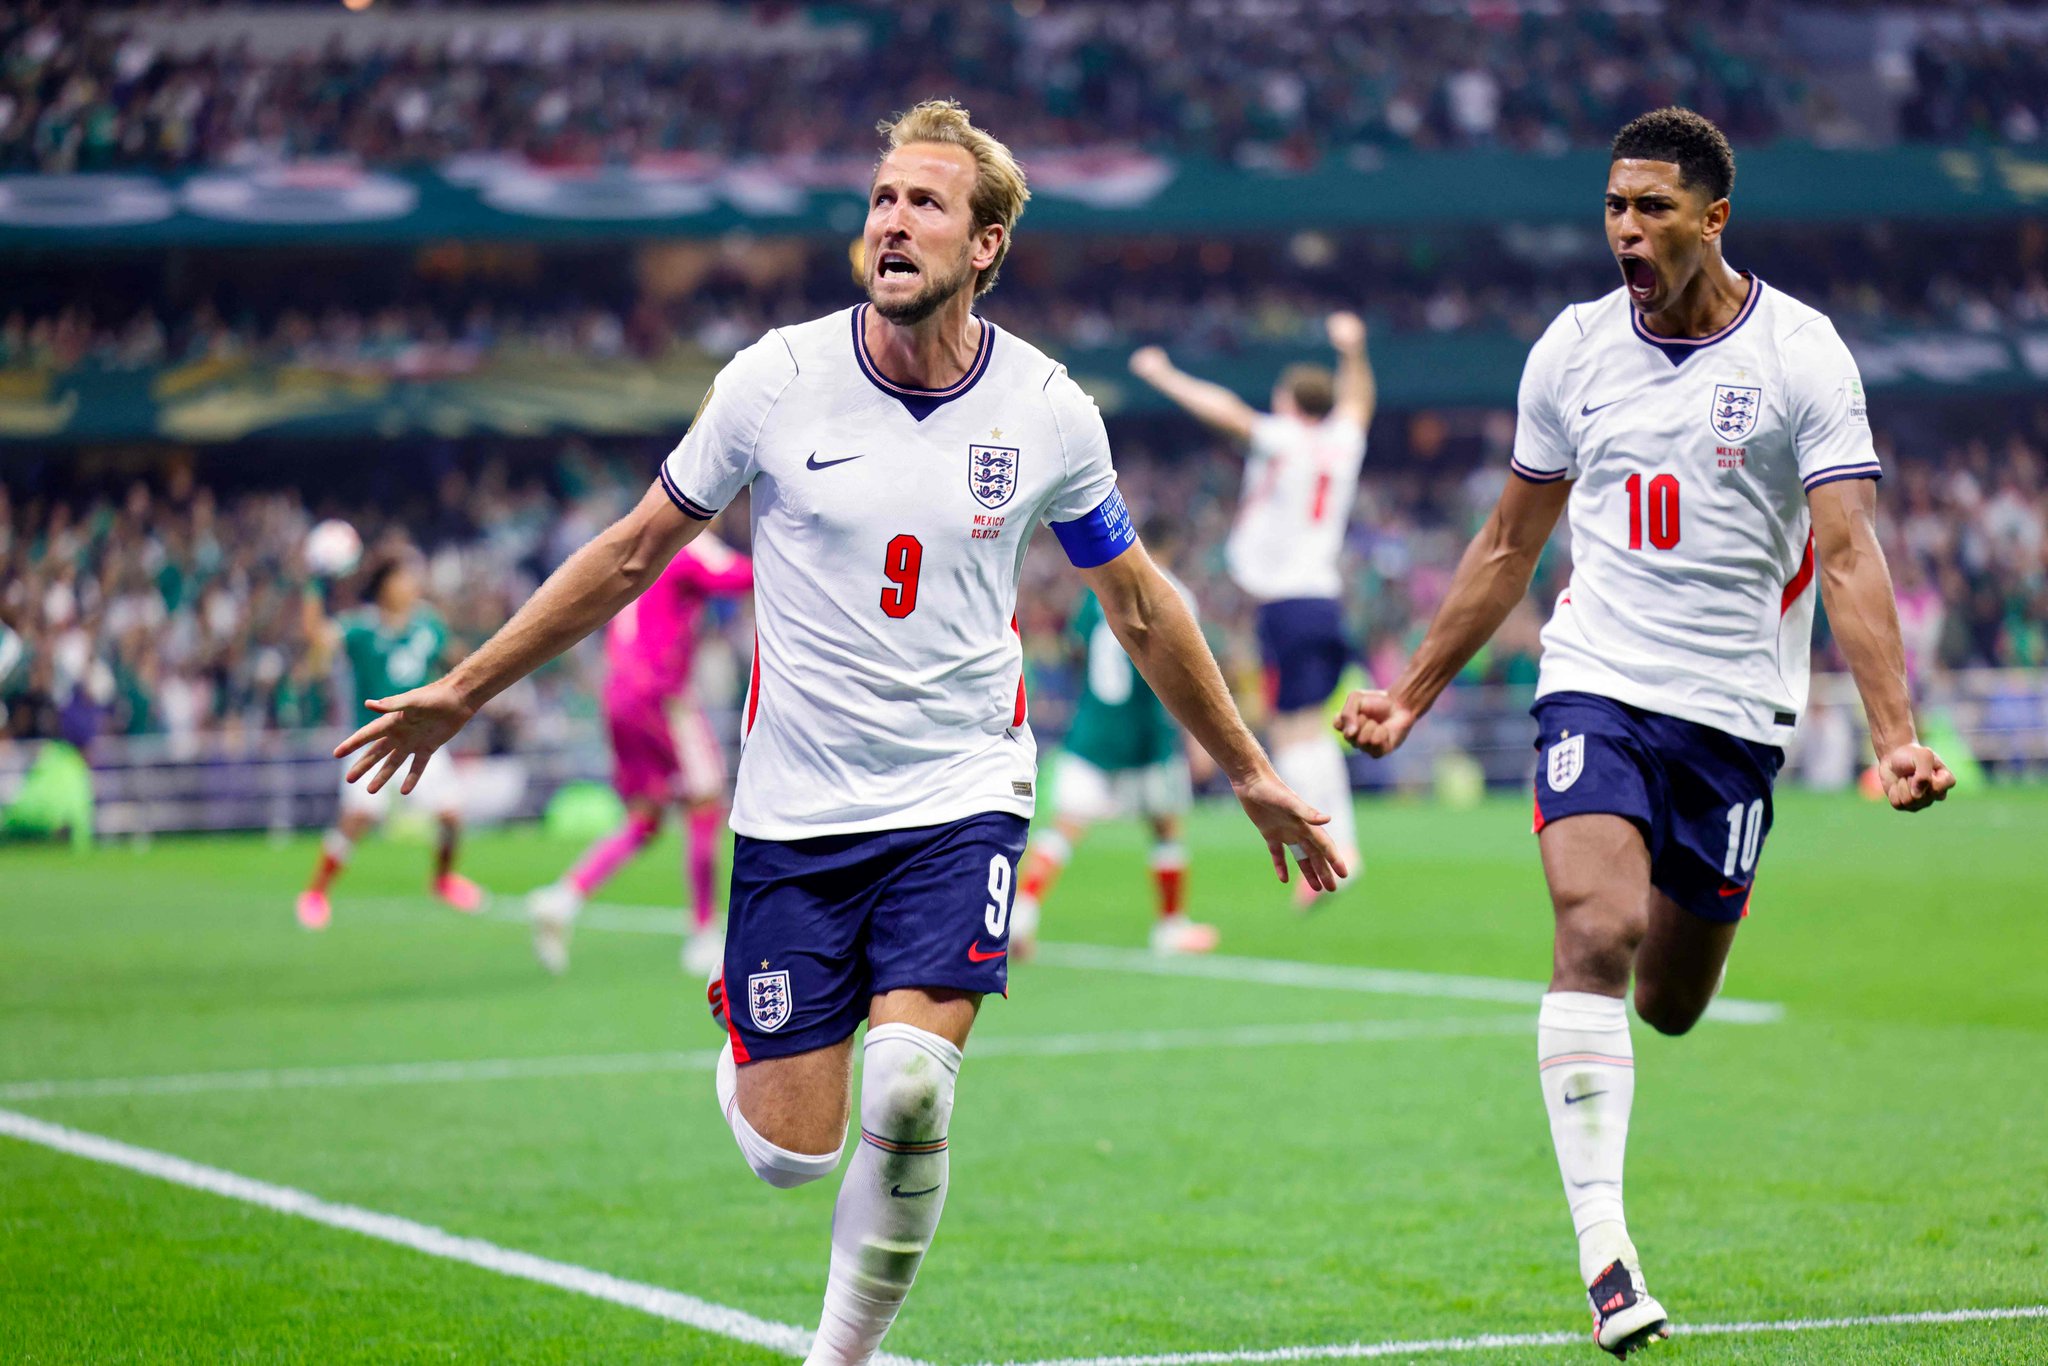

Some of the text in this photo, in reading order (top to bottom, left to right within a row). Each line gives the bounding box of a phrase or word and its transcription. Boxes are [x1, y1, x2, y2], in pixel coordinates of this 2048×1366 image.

[1716, 447, 1746, 456] MEXICO
[971, 529, 1000, 539] 05.07.26
[973, 514, 1005, 527] MEXICO
[1103, 493, 1127, 529] UNITE
[1625, 473, 1681, 550] 10
[880, 533, 923, 619] 9
[1723, 798, 1764, 877] 10
[984, 853, 1011, 938] 9
